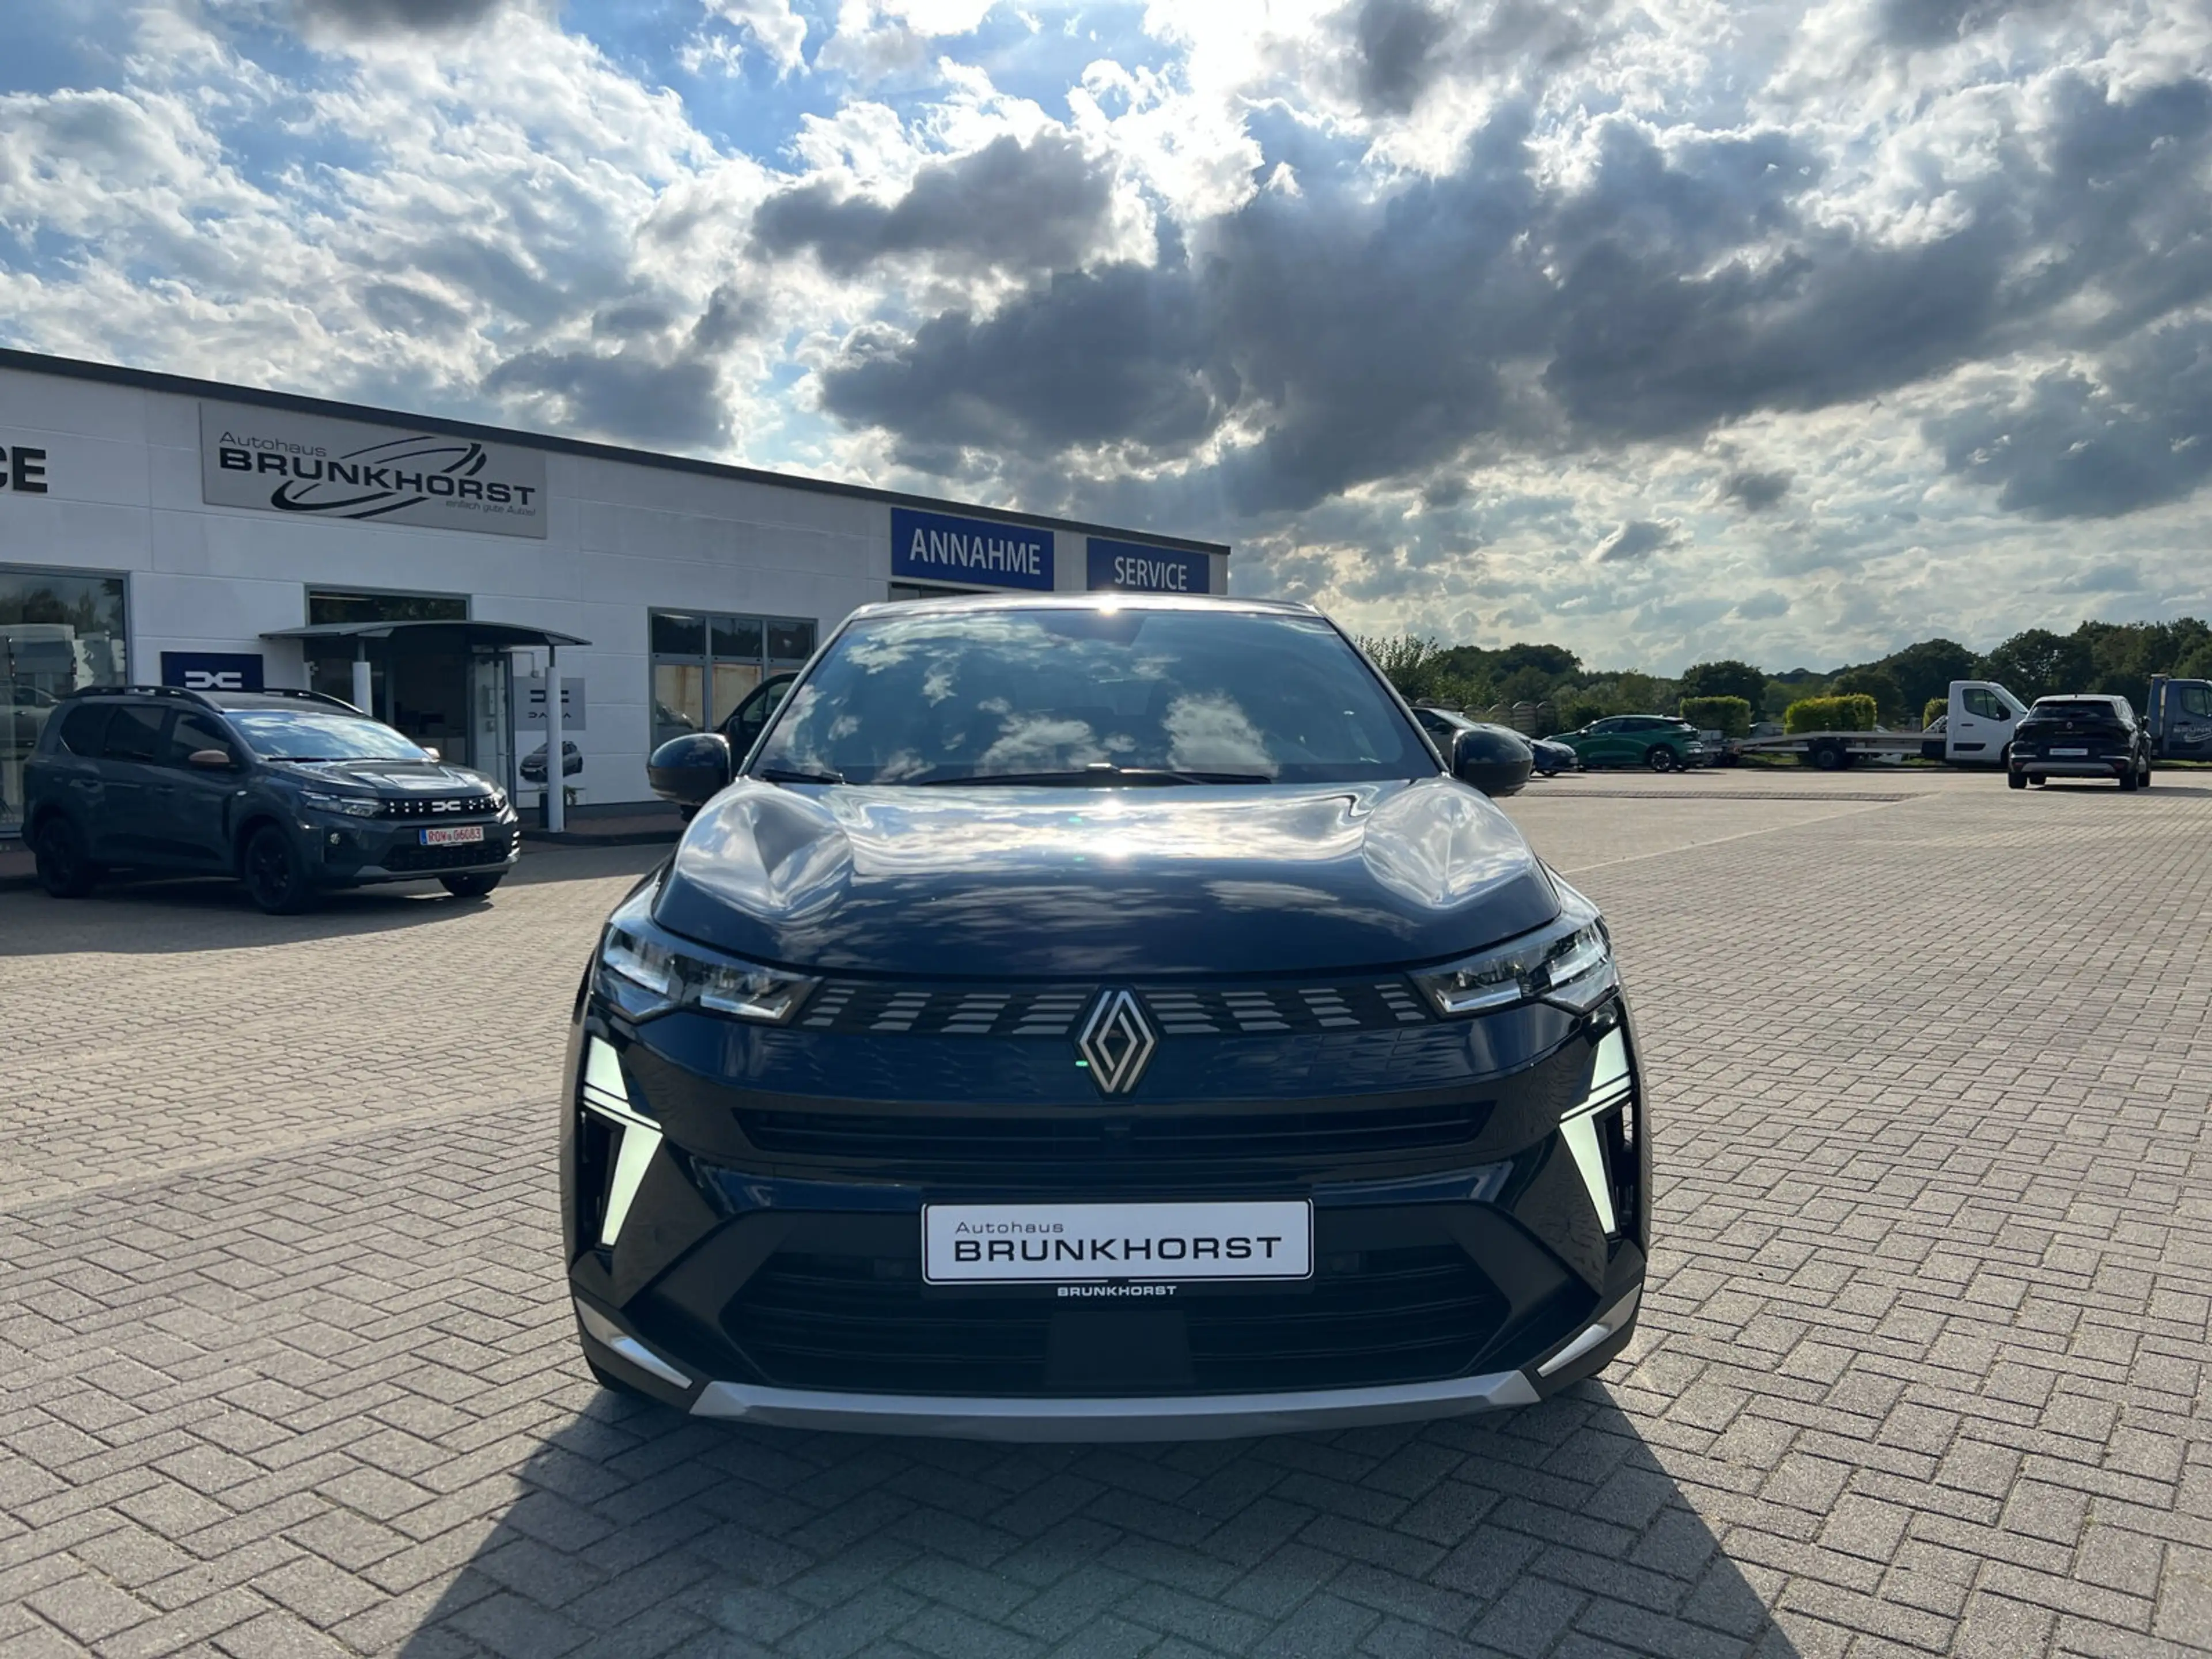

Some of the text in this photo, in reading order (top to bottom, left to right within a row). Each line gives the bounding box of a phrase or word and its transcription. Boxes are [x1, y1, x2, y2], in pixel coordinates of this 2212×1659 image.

[219, 431, 327, 457] Autohaus
[219, 447, 536, 505] BRUNKHORST
[909, 528, 1041, 575] ANNAHME
[1114, 556, 1187, 590] SERVICE
[955, 1222, 1064, 1234] Autohaus
[955, 1237, 1282, 1262] BRUNKHORST
[1057, 1286, 1177, 1297] BRUNKHORST
